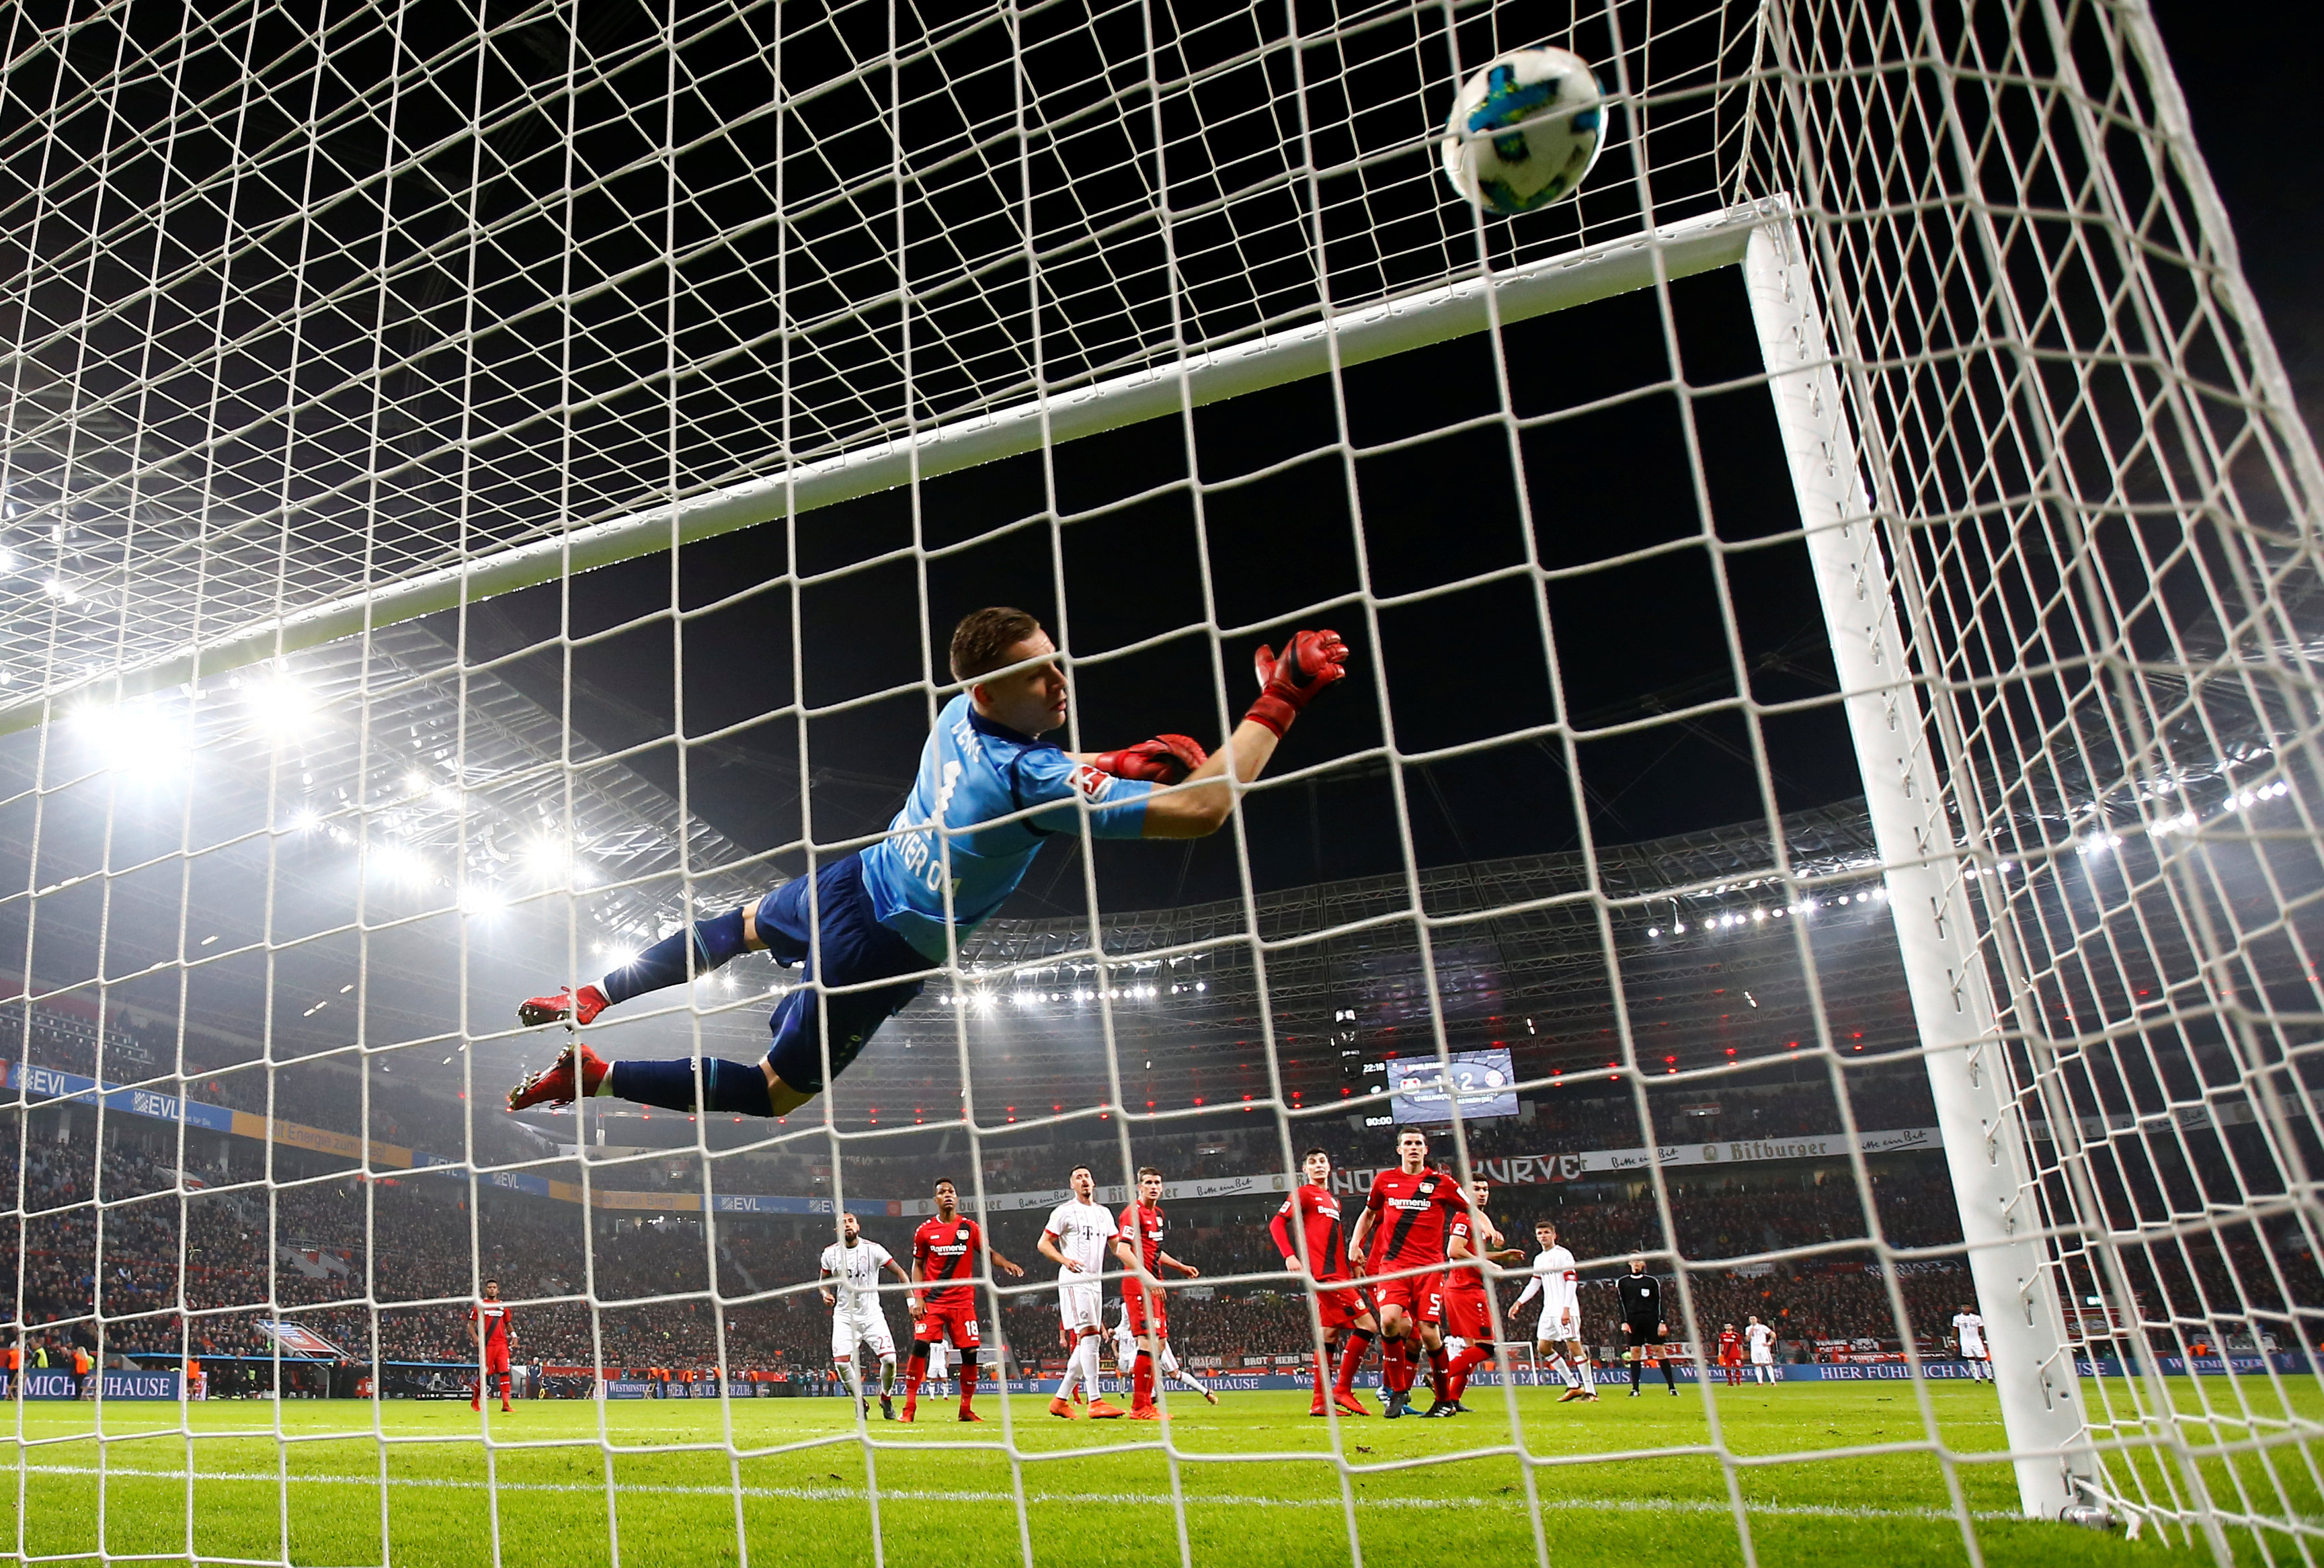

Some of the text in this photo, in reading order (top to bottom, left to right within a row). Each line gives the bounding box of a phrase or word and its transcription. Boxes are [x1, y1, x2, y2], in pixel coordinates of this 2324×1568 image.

[891, 817, 929, 877] AYER
[1363, 1063, 1386, 1072] 22:18
[34, 1071, 69, 1096] EVL
[1459, 1072, 1474, 1090] 2
[149, 1096, 179, 1119] EVL
[1365, 1116, 1393, 1126] 90:00
[288, 1125, 330, 1149] Energie
[335, 1138, 356, 1152] zum
[1903, 1130, 1927, 1141] Bit
[1611, 1157, 1636, 1168] Bitte
[1658, 1148, 1679, 1158] Bit
[1729, 1141, 1827, 1161] Bitburger
[501, 1171, 519, 1190] EVL
[733, 1197, 760, 1210] EVL
[1388, 1197, 1431, 1208] Barmenia
[1429, 1292, 1440, 1311] 5
[965, 1319, 979, 1337] 18
[877, 1335, 893, 1350] 23
[1820, 1366, 1862, 1379] HIER
[1923, 1365, 1954, 1378] ICH
[2167, 1358, 2265, 1368] WSTMISTER
[24, 1376, 75, 1396] MICH
[1098, 1379, 1130, 1391] FÜH'
